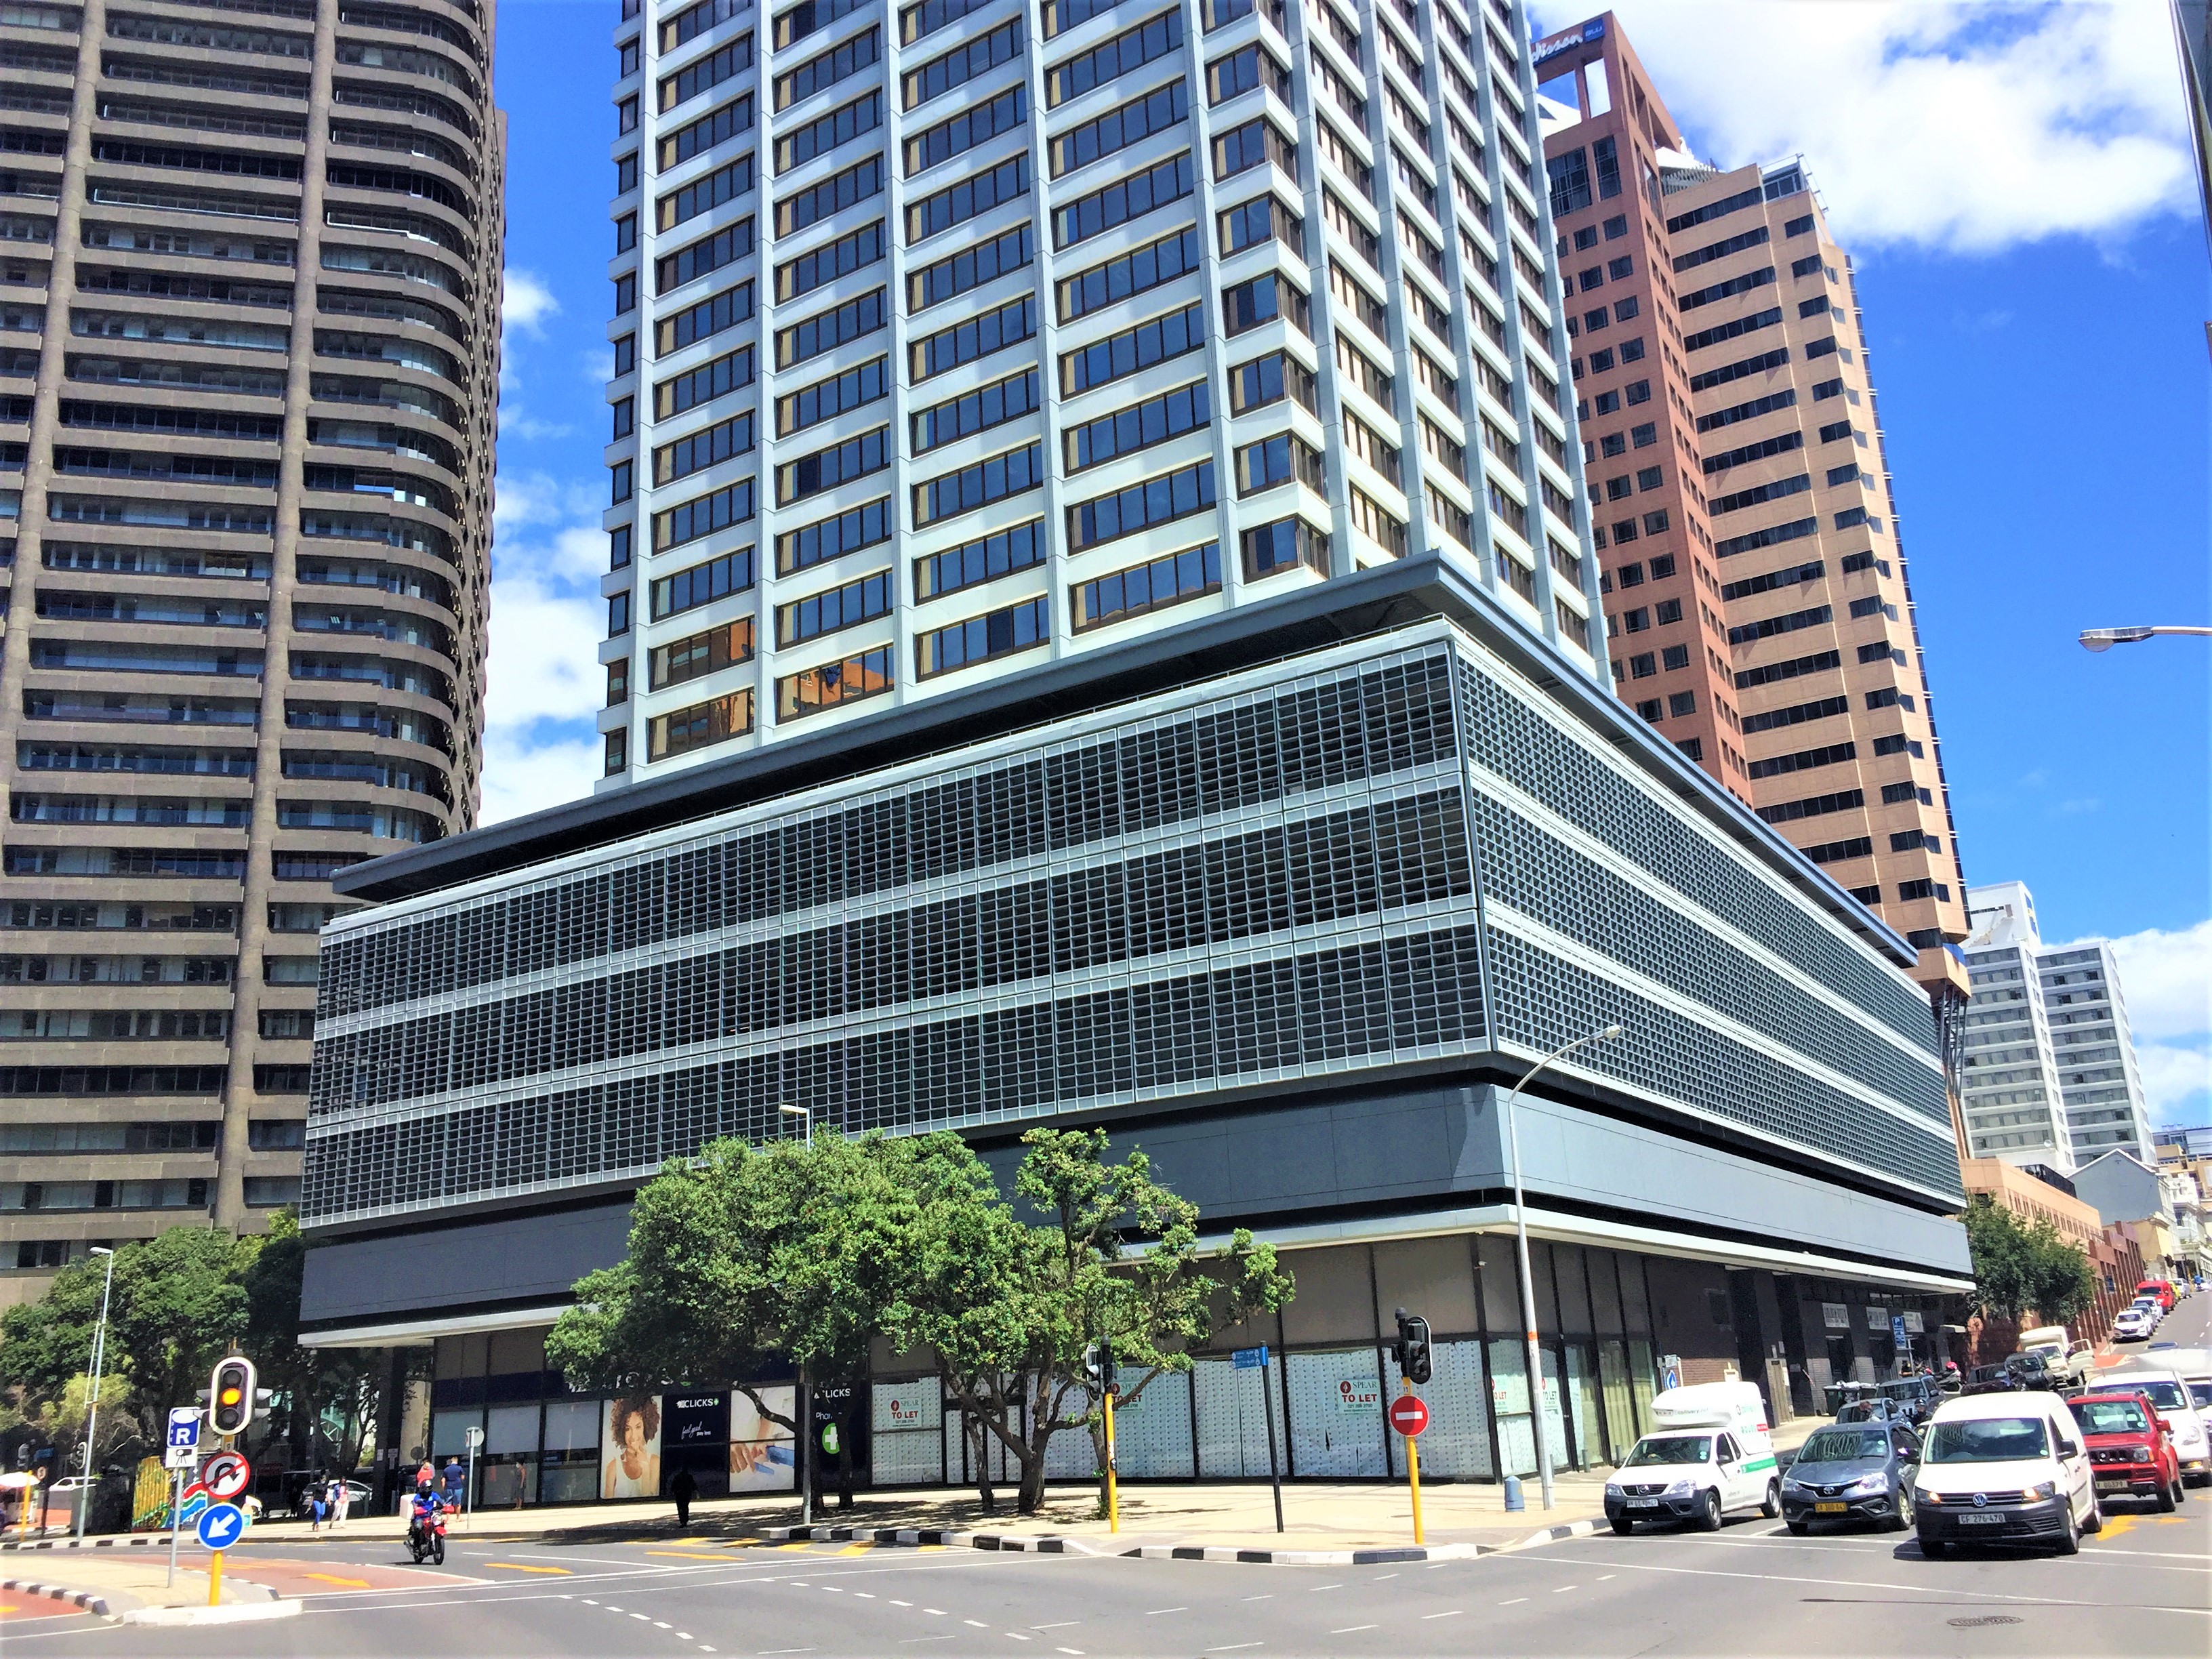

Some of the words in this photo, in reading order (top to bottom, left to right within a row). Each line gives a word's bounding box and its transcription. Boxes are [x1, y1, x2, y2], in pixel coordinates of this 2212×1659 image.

[1532, 34, 1583, 62] disson
[1352, 1381, 1378, 1389] SPEAR
[821, 1388, 851, 1398] LICKS
[1341, 1395, 1355, 1403] TO
[1359, 1393, 1378, 1403] LET
[684, 1398, 714, 1408] CLICKS
[904, 1410, 919, 1418] LET
[176, 1428, 190, 1444] R
